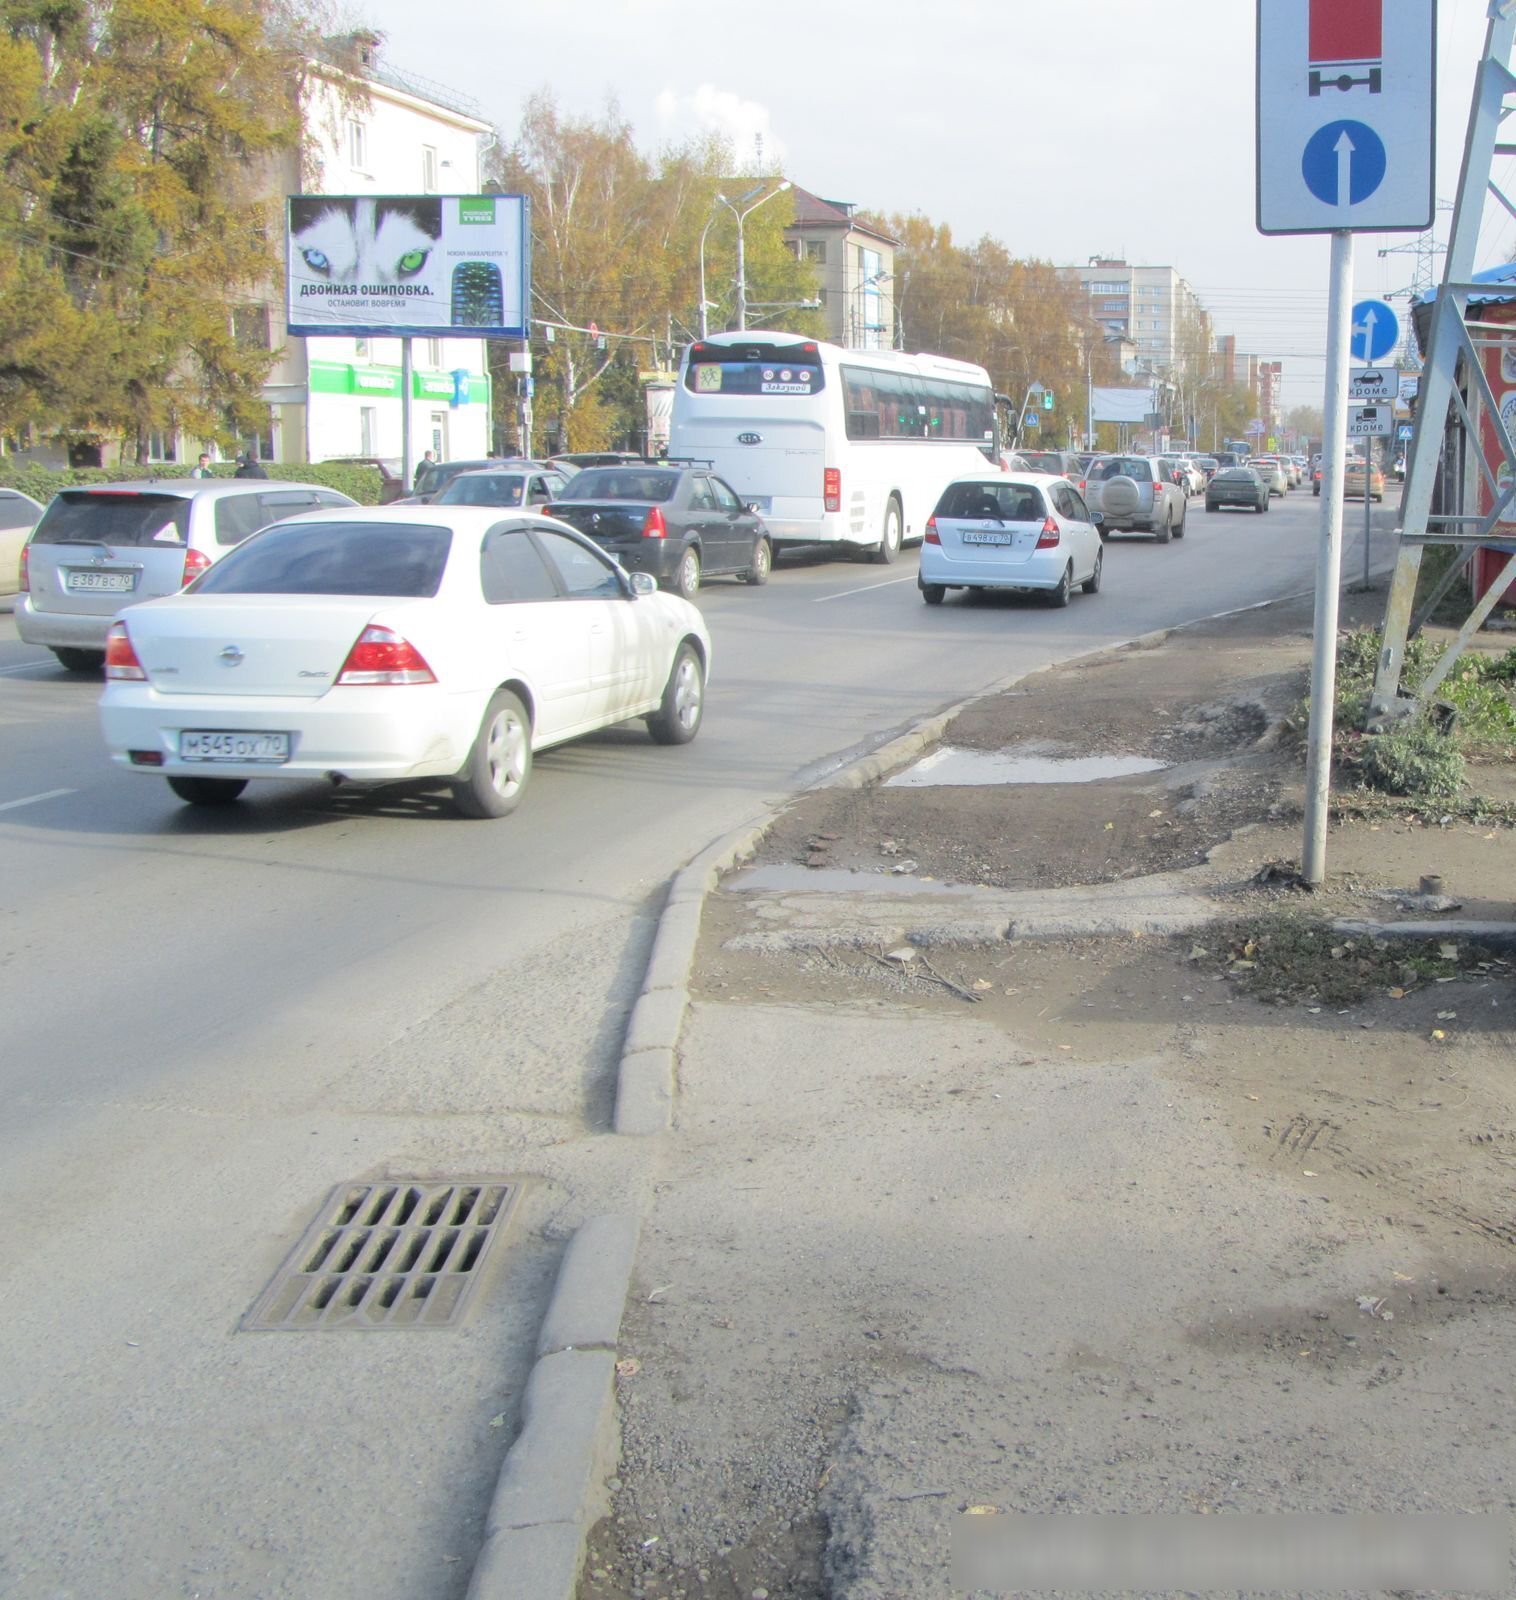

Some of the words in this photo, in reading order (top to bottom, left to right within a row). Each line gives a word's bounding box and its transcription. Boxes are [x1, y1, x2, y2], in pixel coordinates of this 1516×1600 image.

[300, 283, 358, 297] ДВОЙНАЯ
[361, 284, 434, 296] ОШИПОВКА.
[327, 299, 369, 308] ОСТАНОВИТ
[371, 299, 406, 308] ВОВРЕМЯ
[766, 383, 807, 392] Заказной
[1349, 387, 1388, 397] кроме
[1350, 424, 1384, 433] кроме
